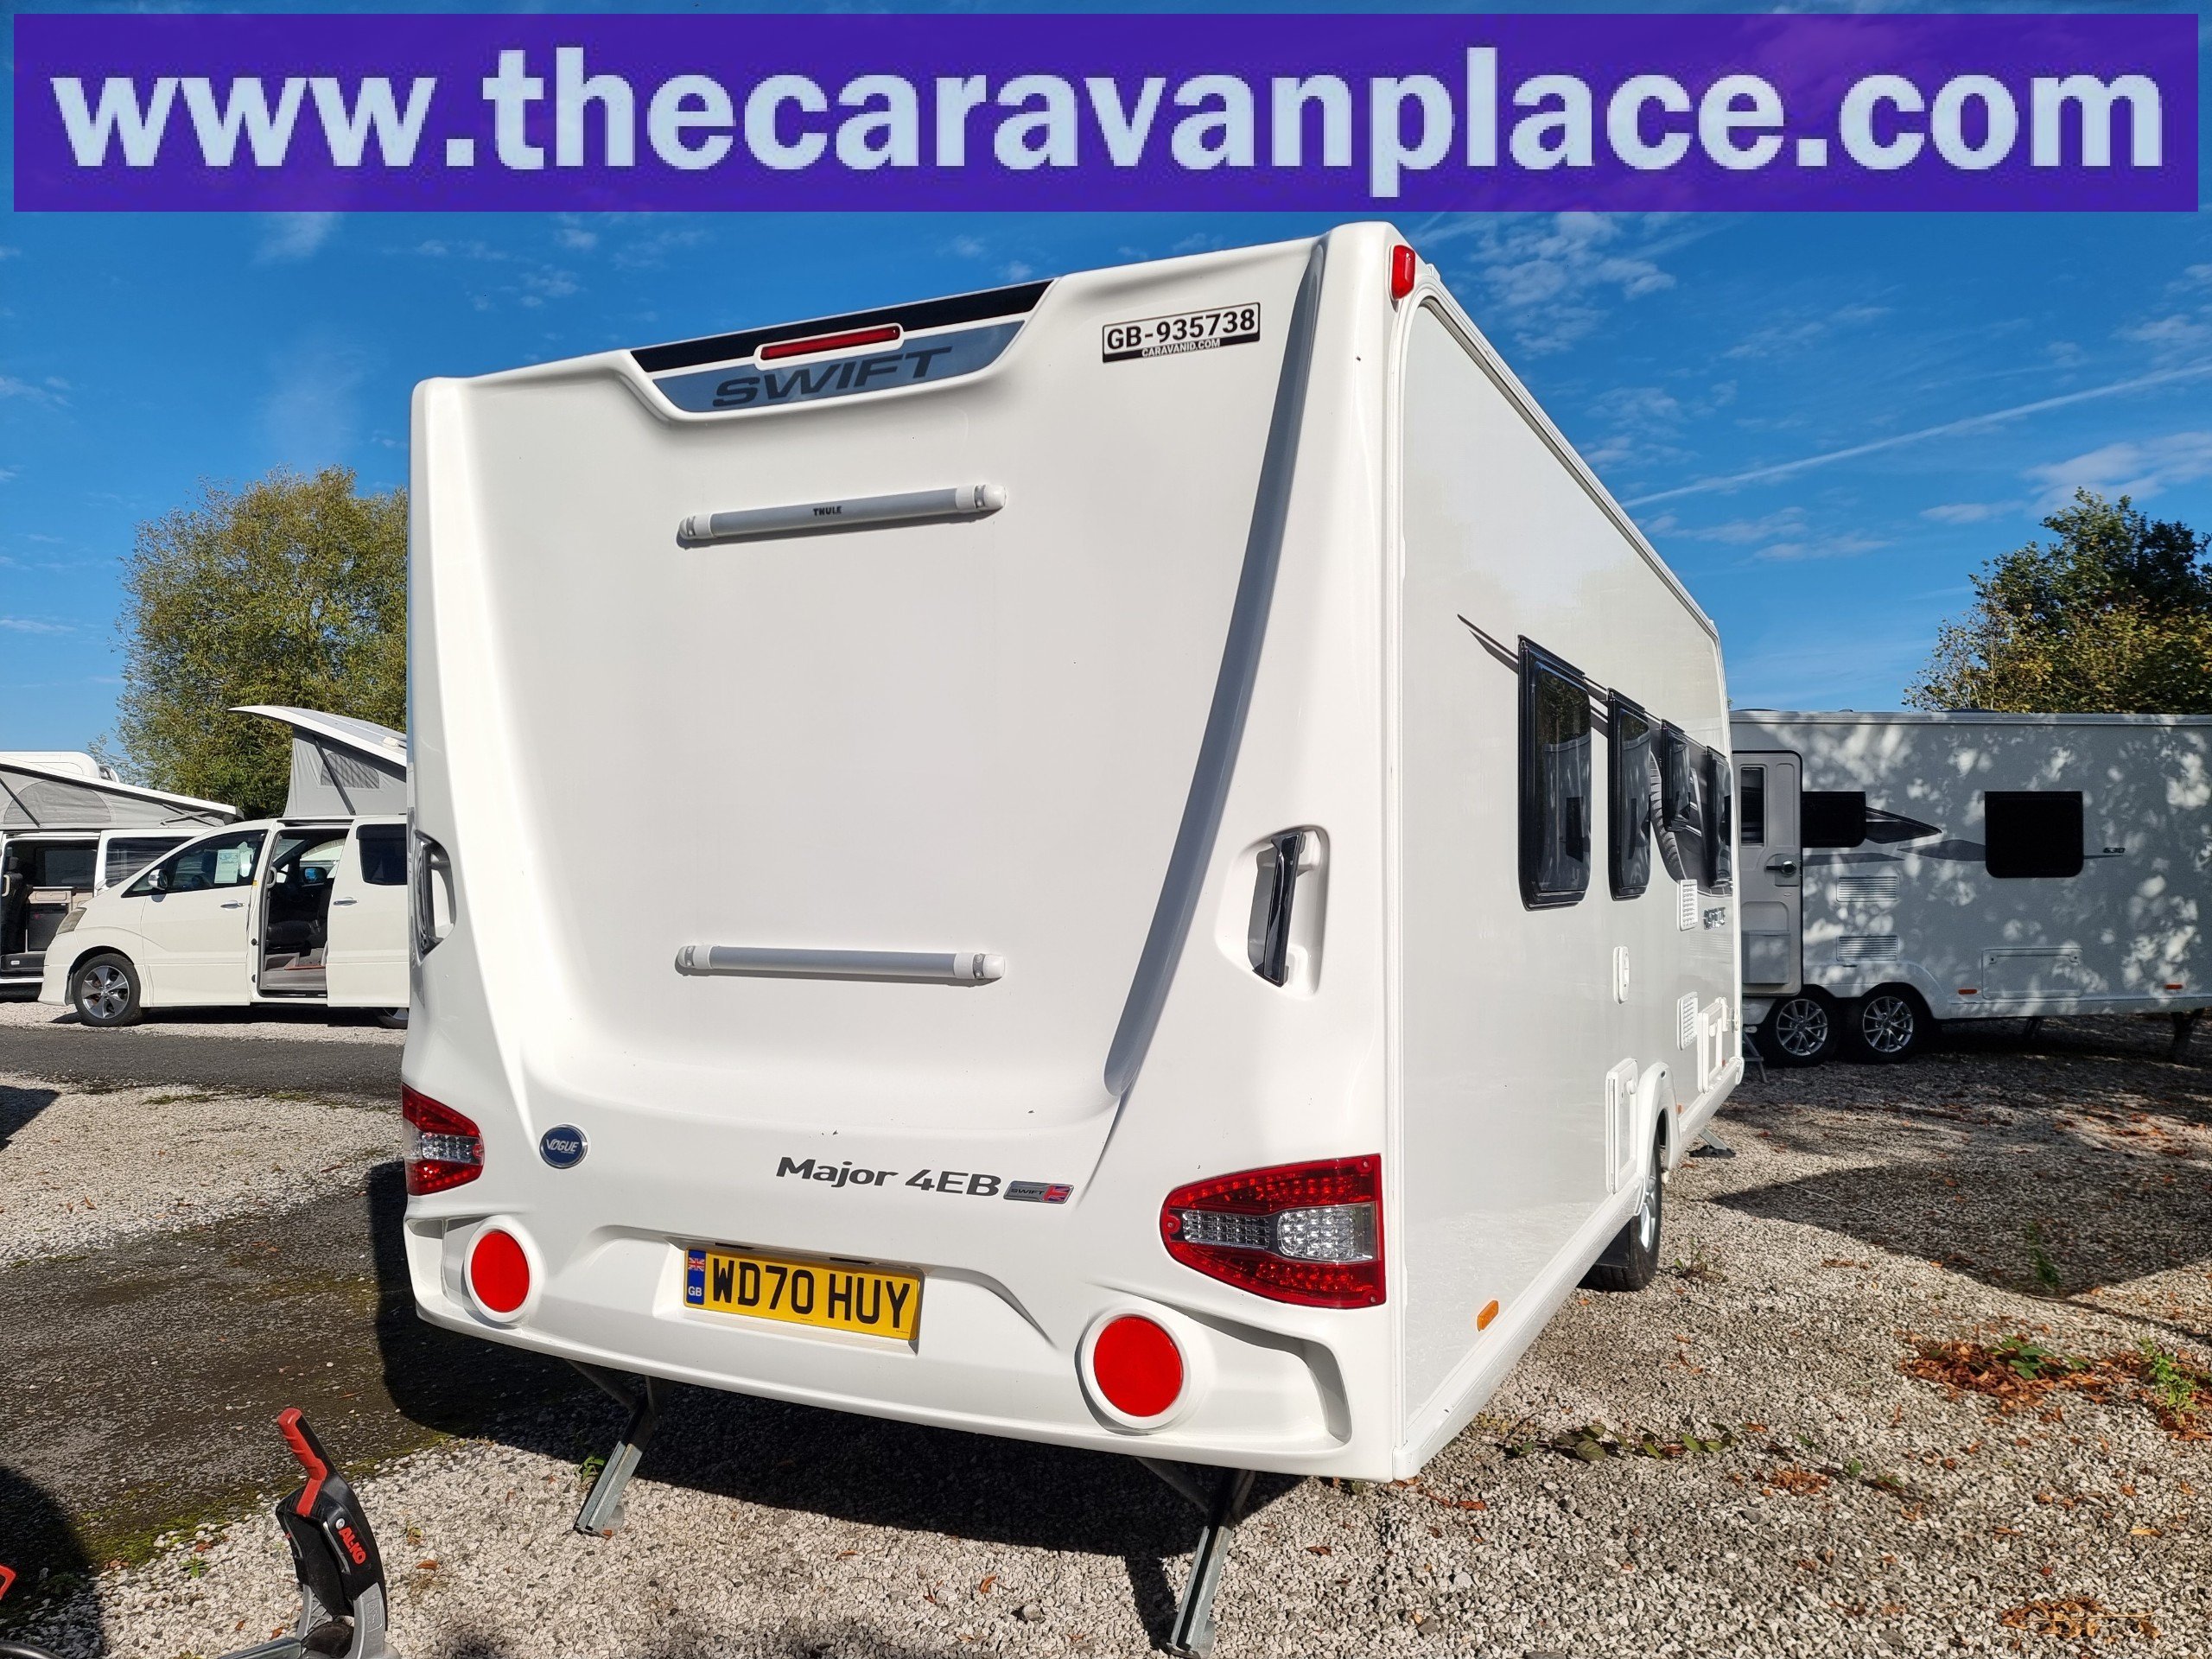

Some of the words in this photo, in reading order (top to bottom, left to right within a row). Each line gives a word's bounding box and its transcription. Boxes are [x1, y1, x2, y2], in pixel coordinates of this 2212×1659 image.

[1107, 308, 1255, 350] GB-935738
[1141, 337, 1221, 358] CARAVANID.COM
[712, 346, 953, 407] SWIFT
[812, 505, 842, 516] THULE
[545, 1138, 580, 1153] VOGUE
[776, 1156, 899, 1188] Major
[905, 1169, 1001, 1197] 4EB
[688, 1286, 702, 1297] GB
[713, 1258, 815, 1315] WD70
[827, 1273, 911, 1329] HUY
[338, 1527, 366, 1565] AL-KO
